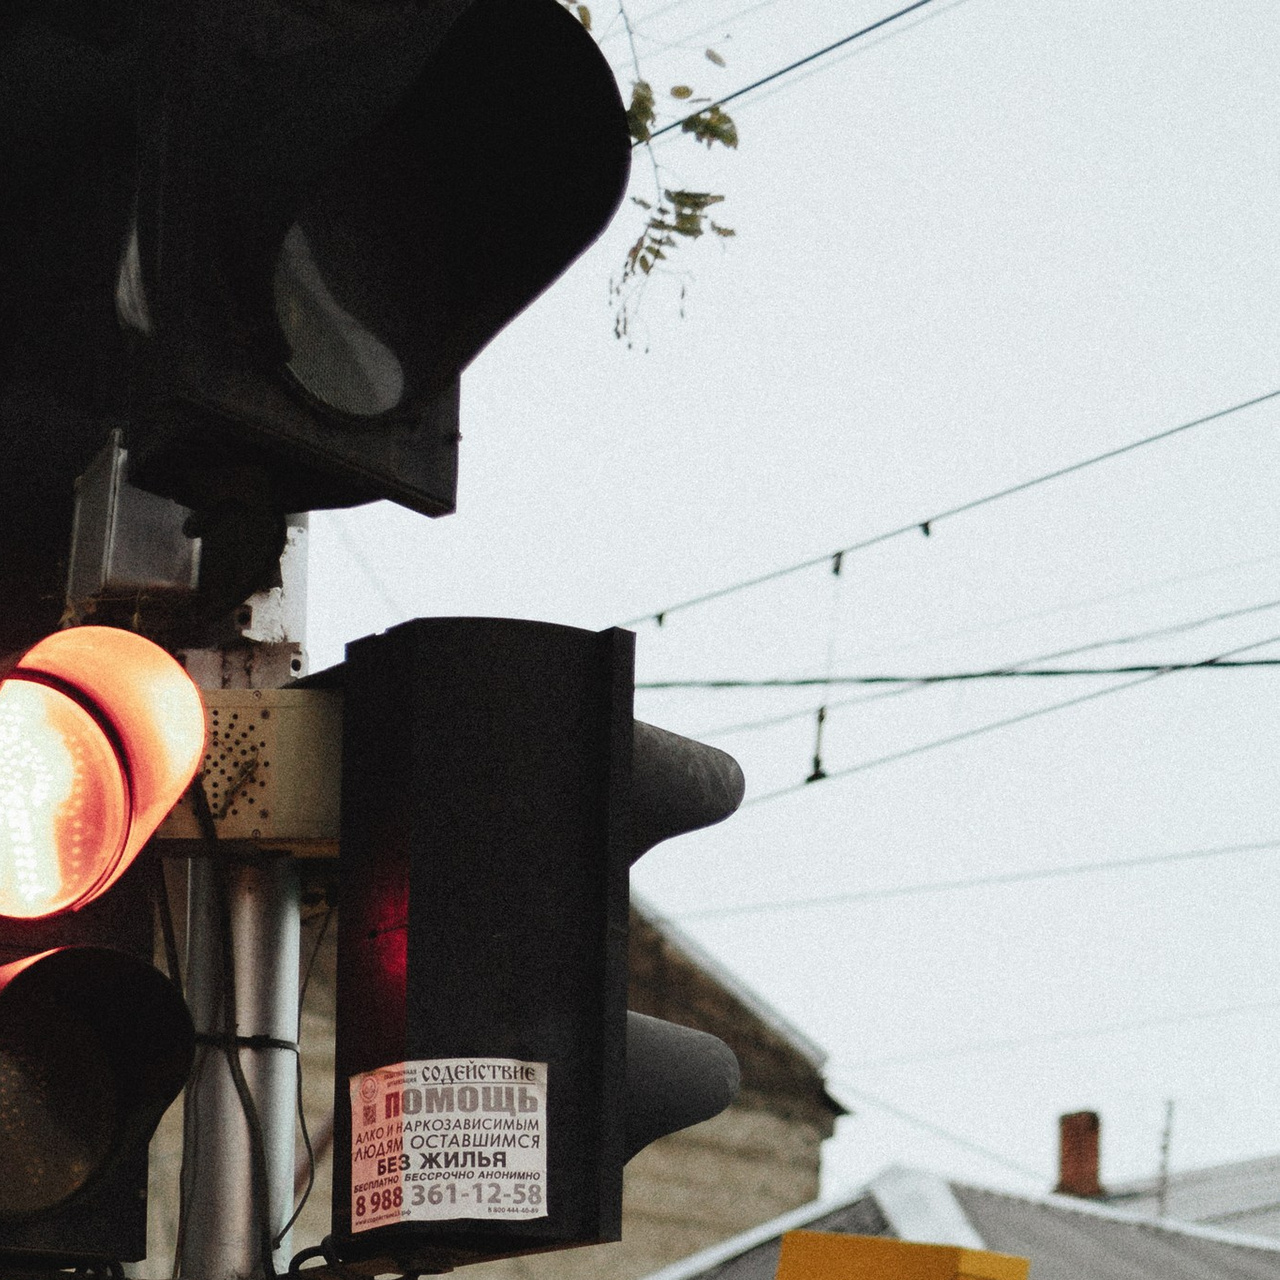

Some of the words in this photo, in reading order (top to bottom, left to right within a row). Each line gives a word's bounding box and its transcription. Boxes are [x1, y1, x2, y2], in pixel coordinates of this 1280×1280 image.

[421, 1060, 536, 1085] СОДЕЙСТВИЕ
[384, 1086, 539, 1119] ПОМОЩЬ
[355, 1127, 385, 1146] АЛКО
[386, 1124, 394, 1137] И
[395, 1118, 540, 1135] НАРКОЗАВИСИМЫМ
[354, 1137, 404, 1162] ЛЮДЯМ
[410, 1133, 541, 1150] ОСТАВШИМСЯ
[377, 1153, 411, 1177] БЕЗ
[420, 1151, 507, 1169] ЖИЛЬЯ
[353, 1175, 400, 1194] БЕСПЛАТНО
[404, 1170, 475, 1182] БЕССРОЧНО
[478, 1170, 541, 1181] АНОНИМНО
[355, 1195, 366, 1217] 8
[370, 1186, 404, 1214] 988
[411, 1182, 542, 1206] 361-12-58
